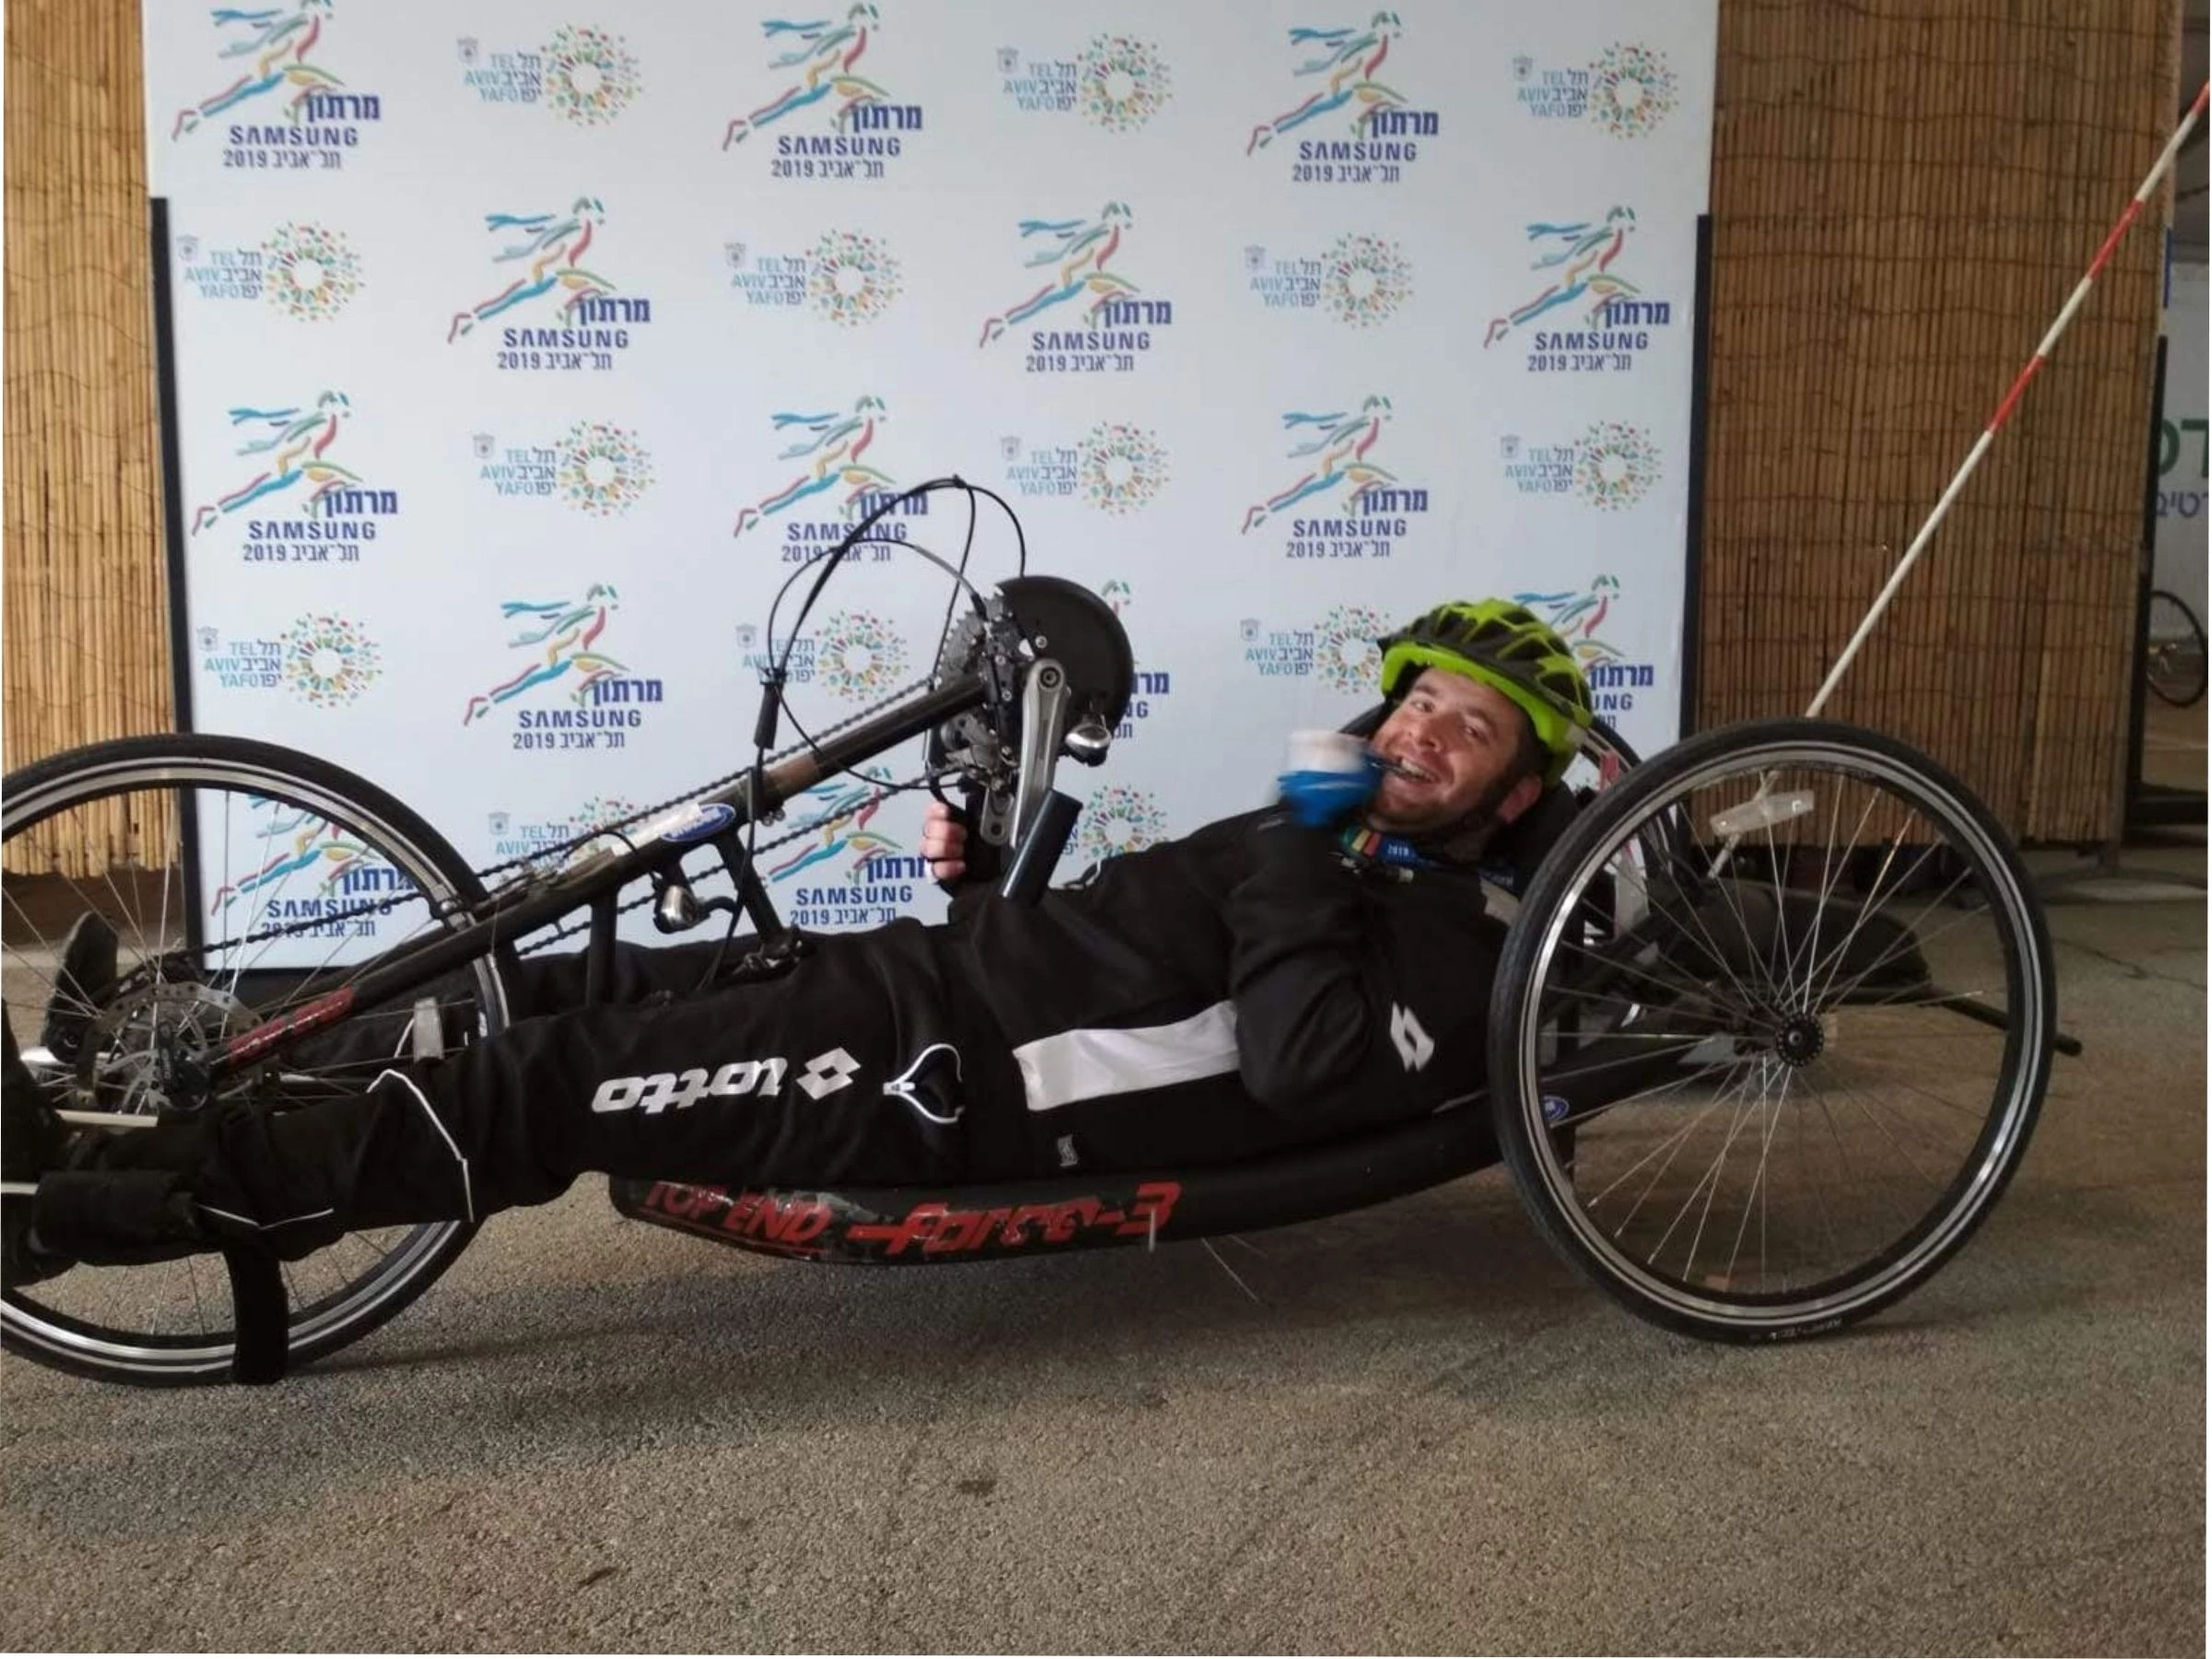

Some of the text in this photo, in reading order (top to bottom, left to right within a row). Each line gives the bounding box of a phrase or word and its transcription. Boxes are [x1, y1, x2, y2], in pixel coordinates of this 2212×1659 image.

[307, 94, 380, 122] מרתון
[851, 105, 922, 132] מרתון
[1371, 111, 1438, 136] מרתון
[229, 126, 358, 146] SAMSUNG
[778, 135, 901, 156] SAMSUNG
[223, 149, 266, 169] 2019
[1300, 142, 1418, 160] SAMSUNG
[771, 159, 813, 178] 2019
[1292, 164, 1333, 182] 2019
[579, 298, 650, 325] מרתון
[1104, 300, 1171, 327] מרתון
[1606, 301, 1669, 327] מרתון
[503, 328, 629, 347] SAMSUNG
[1032, 332, 1150, 350] SAMSUNG
[1535, 332, 1648, 350] SAMSUNG
[497, 351, 539, 371] 2019
[1026, 354, 1065, 372] 2019
[1528, 354, 1566, 371] 2019
[325, 490, 397, 516] מרתון
[1361, 489, 1428, 515] מרתון
[248, 521, 376, 540] SAMSUNG
[1293, 520, 1406, 536] SAMSUNG
[242, 543, 286, 561] 2019
[1286, 541, 1324, 558] 2019
[1589, 665, 1653, 690] מרתון
[593, 679, 663, 706] מרתון
[519, 710, 641, 728] SAMSUNG
[512, 732, 555, 749] 2019
[795, 887, 912, 904] SAMSUNG
[791, 909, 830, 925] 2019
